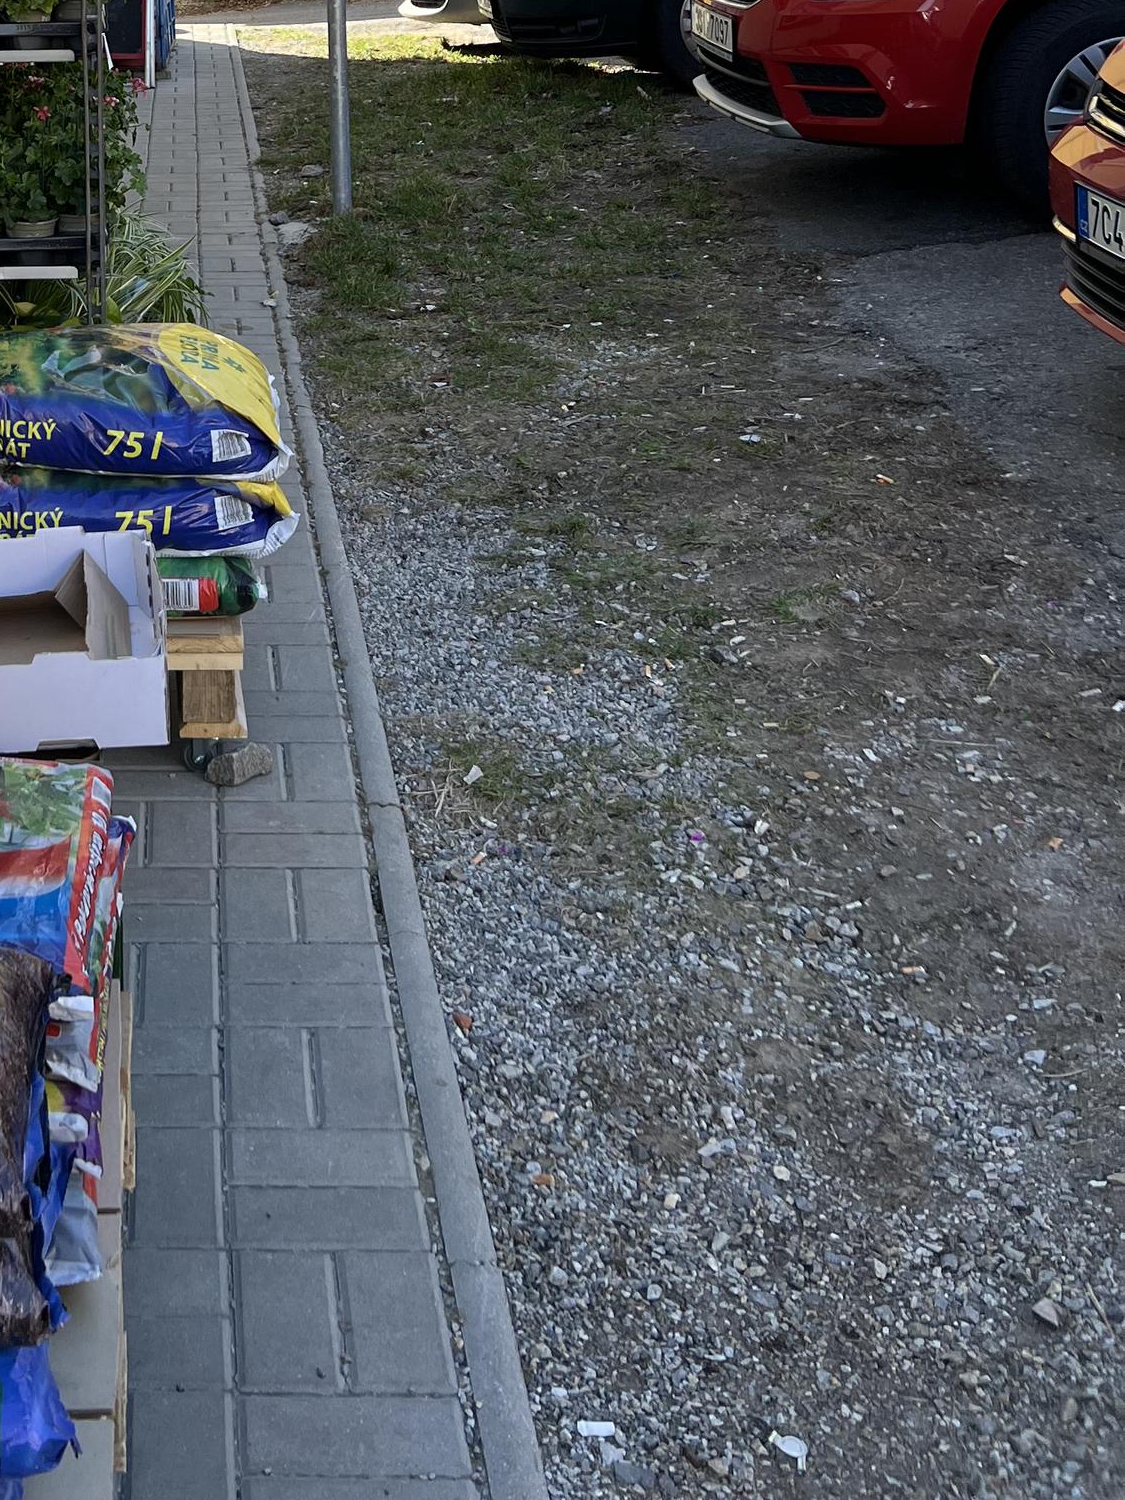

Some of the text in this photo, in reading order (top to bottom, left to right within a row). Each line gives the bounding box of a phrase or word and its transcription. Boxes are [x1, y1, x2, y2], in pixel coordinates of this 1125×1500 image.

[709, 13, 728, 46] 7097
[1090, 196, 1124, 253] 7C4
[104, 429, 145, 459] 75
[115, 510, 154, 538] 75
